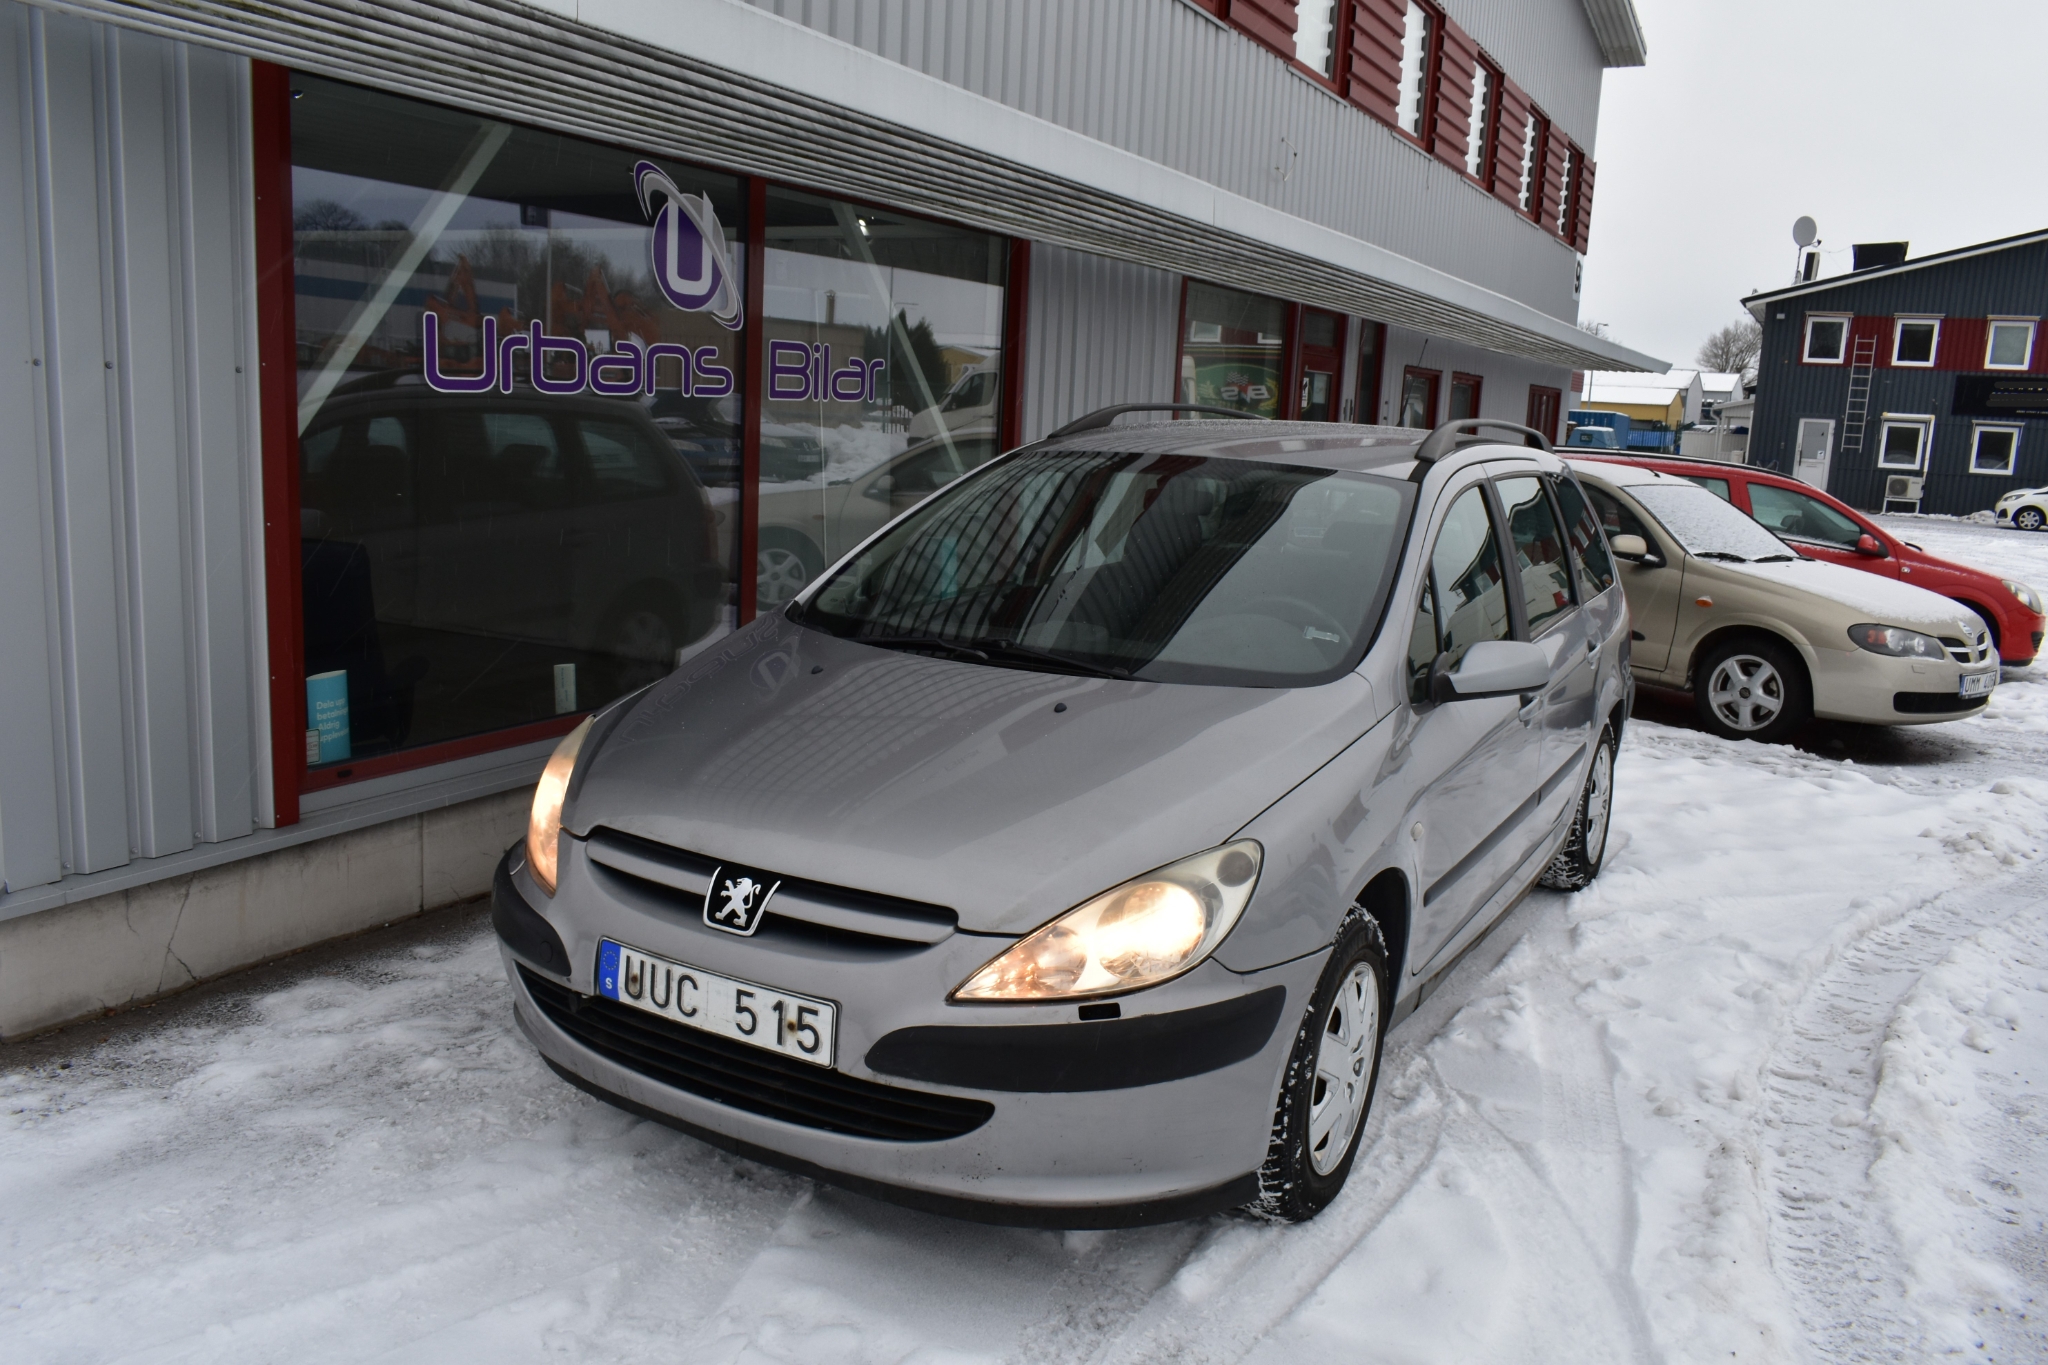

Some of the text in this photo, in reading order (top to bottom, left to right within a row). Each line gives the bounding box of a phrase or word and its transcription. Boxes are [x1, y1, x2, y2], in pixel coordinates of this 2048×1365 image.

[423, 311, 886, 403] Urbans Bilar
[1965, 677, 1981, 693] UMM
[316, 700, 334, 710] Dela
[318, 720, 340, 731] Aldrig
[604, 976, 613, 990] S
[623, 954, 820, 1054] UUC 515
